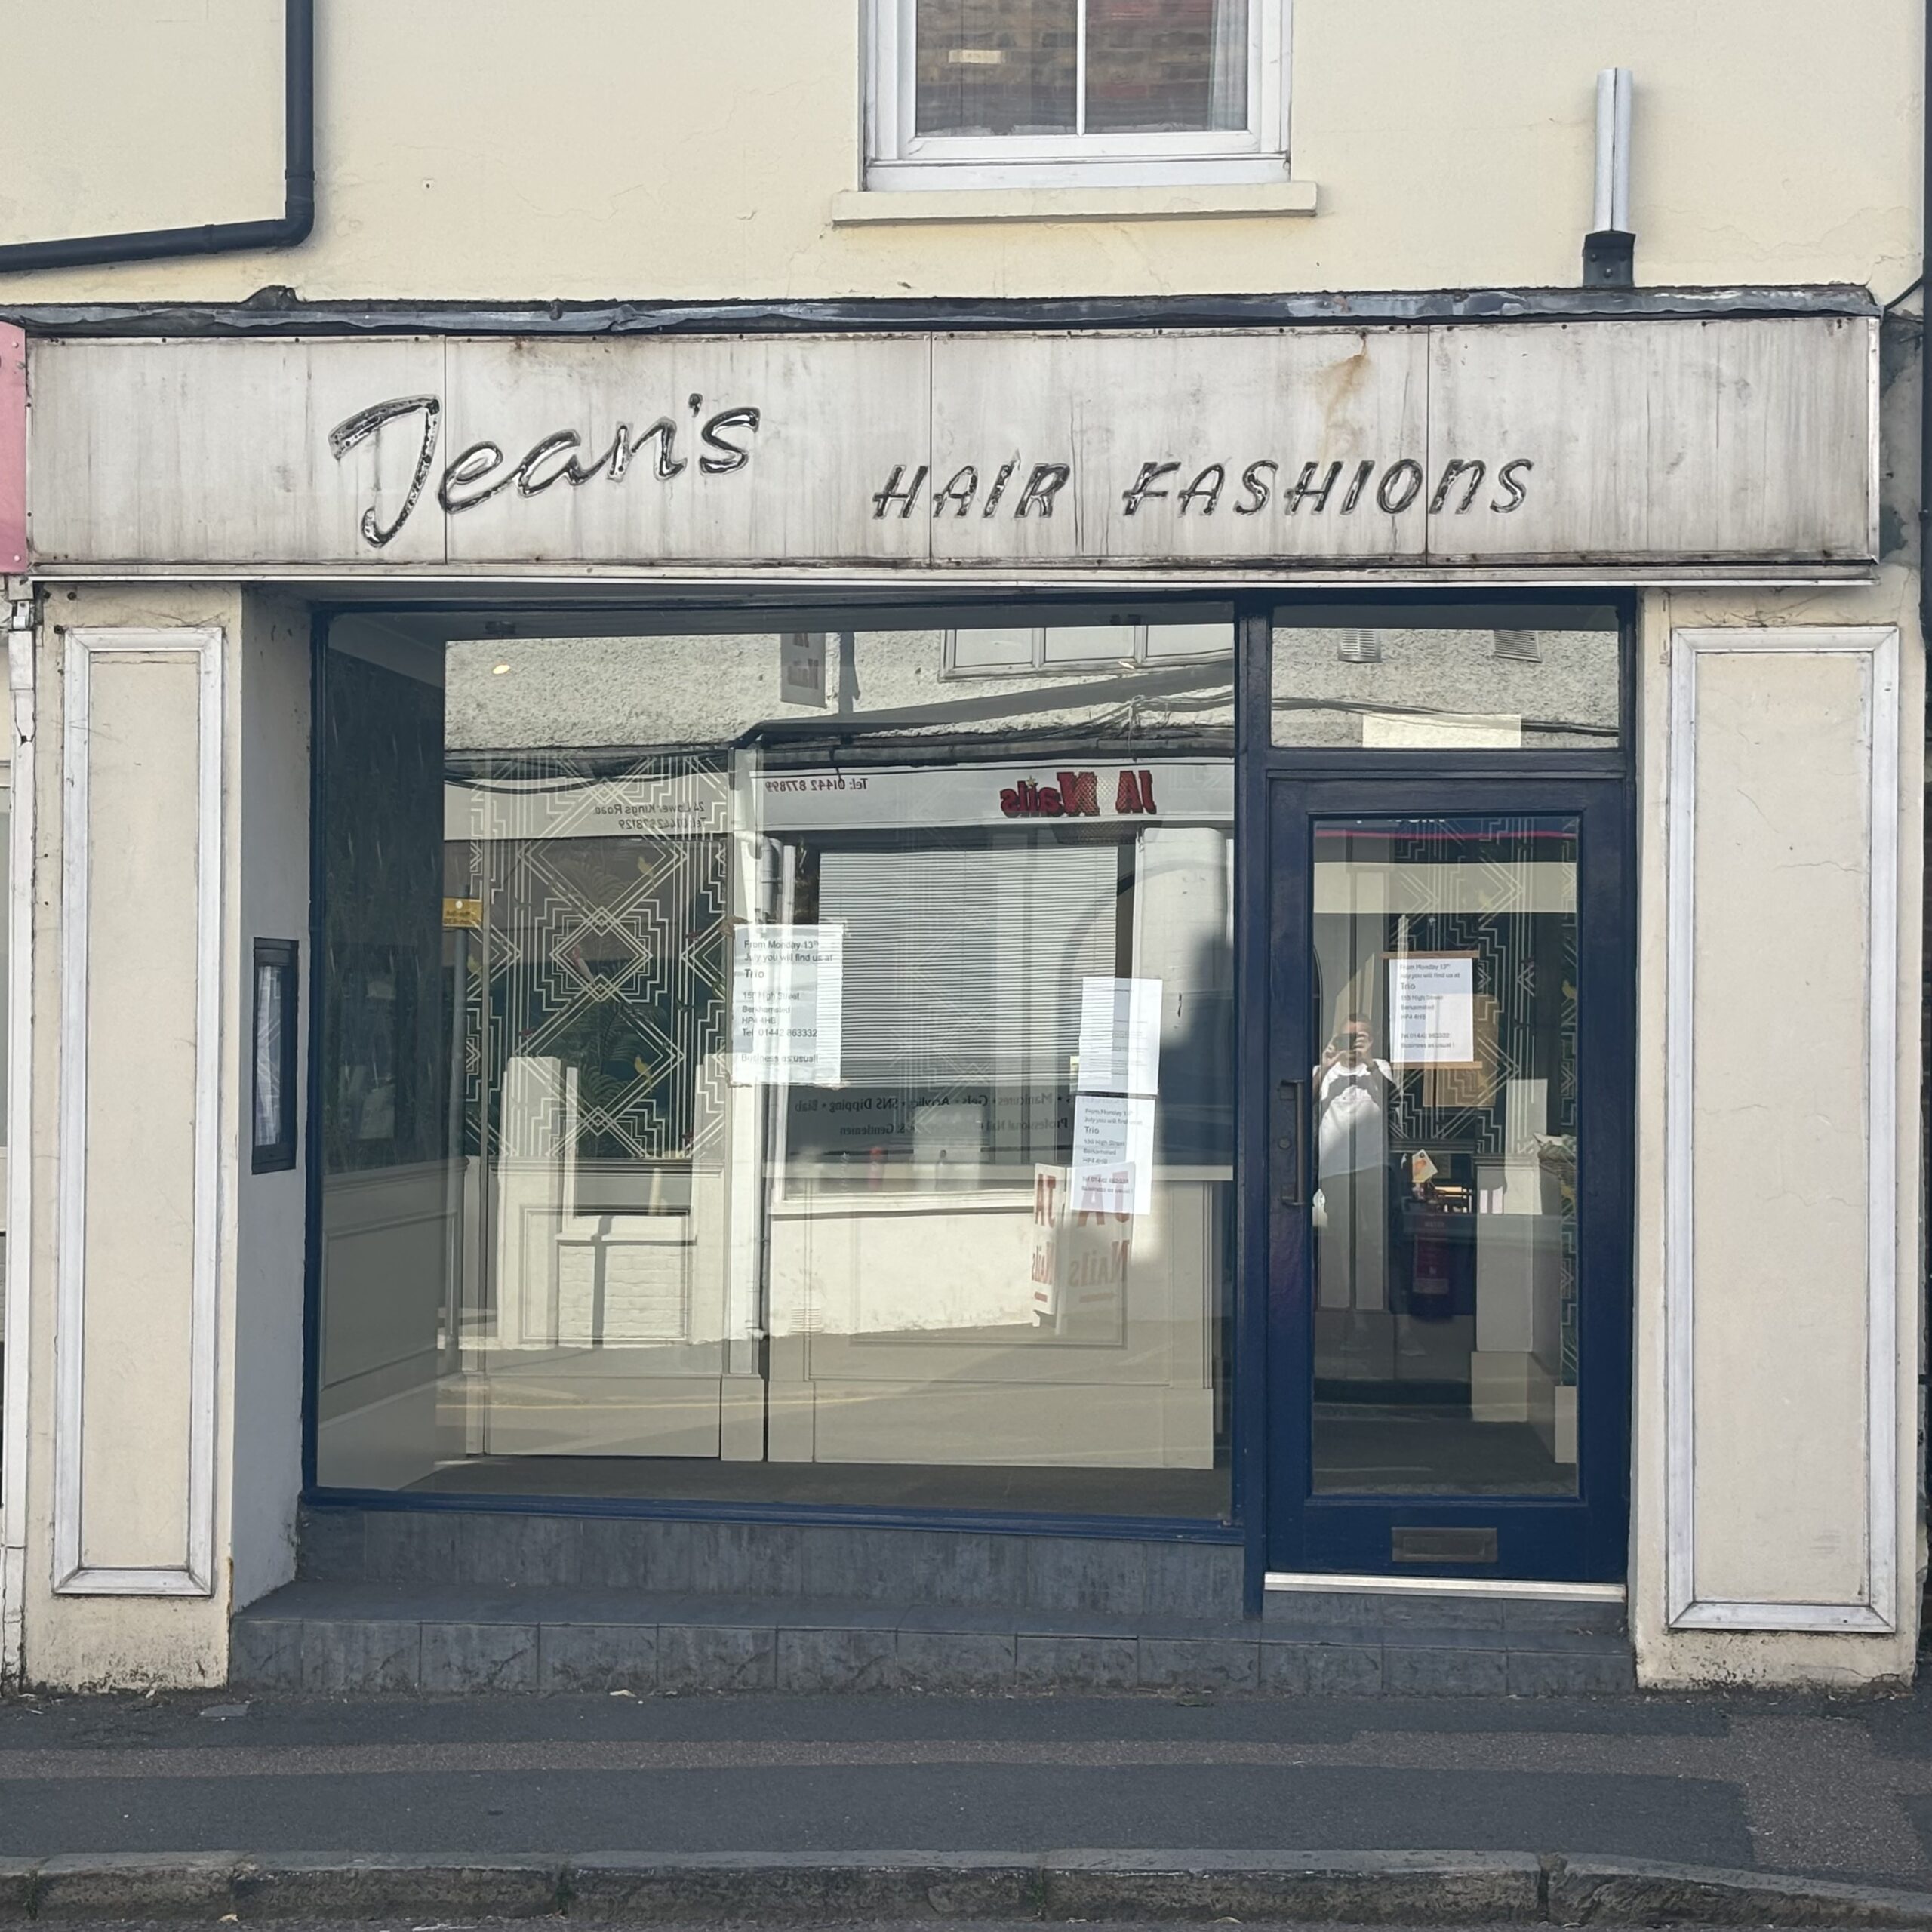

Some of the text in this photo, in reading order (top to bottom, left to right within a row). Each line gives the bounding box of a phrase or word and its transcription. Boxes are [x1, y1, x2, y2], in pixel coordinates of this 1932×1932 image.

[328, 392, 761, 549] Jean's
[872, 458, 1534, 519] HAIR FASHIONS
[744, 940, 766, 949] From
[768, 940, 801, 950] Monday
[780, 953, 793, 961] will
[795, 953, 811, 961] find
[744, 968, 764, 978] Trio
[758, 991, 776, 1001] High
[758, 1029, 785, 1037] 01442
[1084, 1126, 1100, 1134] Trio
